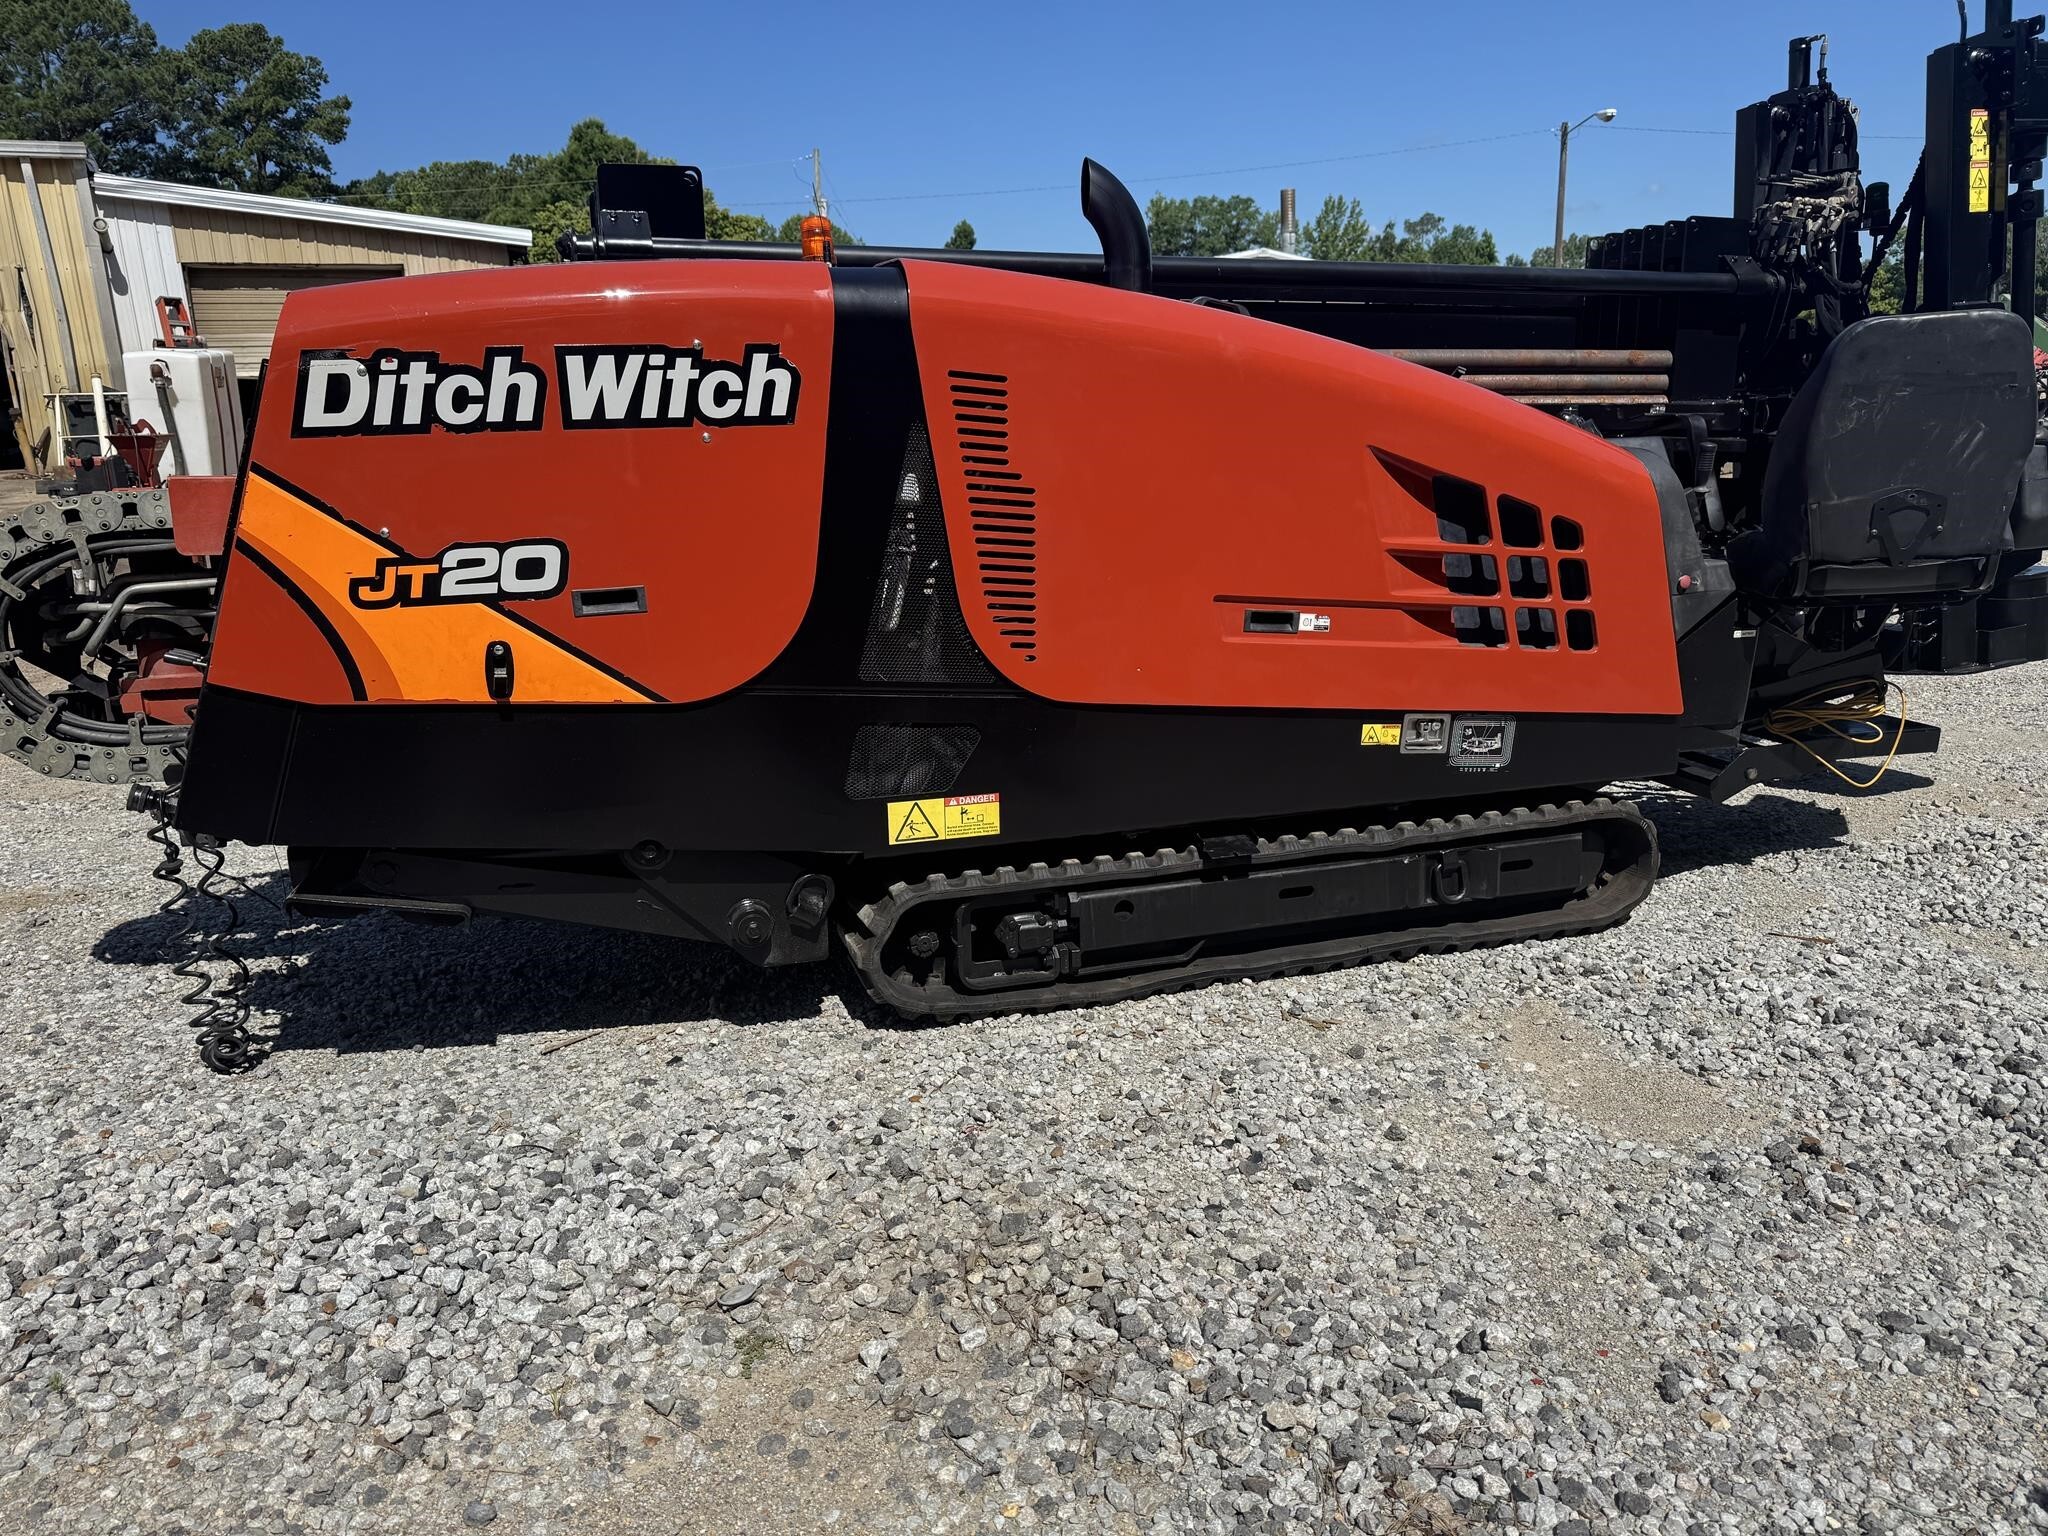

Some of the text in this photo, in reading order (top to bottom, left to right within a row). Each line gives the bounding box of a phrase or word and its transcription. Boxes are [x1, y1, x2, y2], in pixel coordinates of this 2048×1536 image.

[302, 353, 791, 428] Ditch Witch
[358, 544, 562, 602] JT20
[959, 794, 996, 804] DANGER
